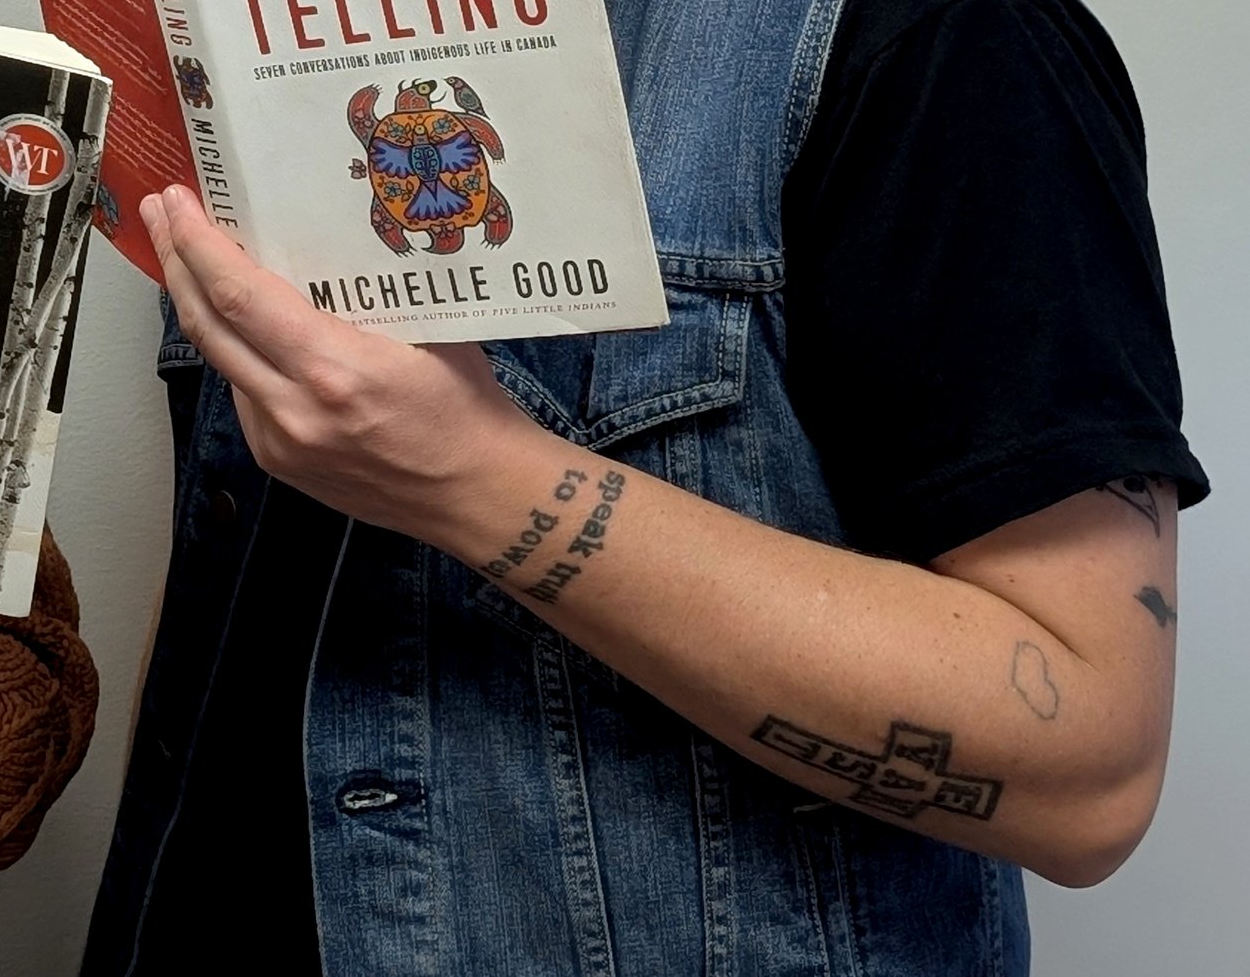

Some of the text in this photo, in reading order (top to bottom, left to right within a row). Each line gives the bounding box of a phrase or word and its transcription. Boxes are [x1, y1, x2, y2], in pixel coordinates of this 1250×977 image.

[253, 34, 557, 81] SEVEN CONVERSATIONS ABOUT INDIGENOUS LIFE IN CANADA
[191, 117, 239, 229] MICHELLE
[308, 258, 610, 315] MICHELLE GOOD
[350, 300, 617, 327] ESTSELLING AUTHOR OF FIVE LITTLE INDIANS
[554, 469, 588, 502] to
[567, 469, 626, 558] speak
